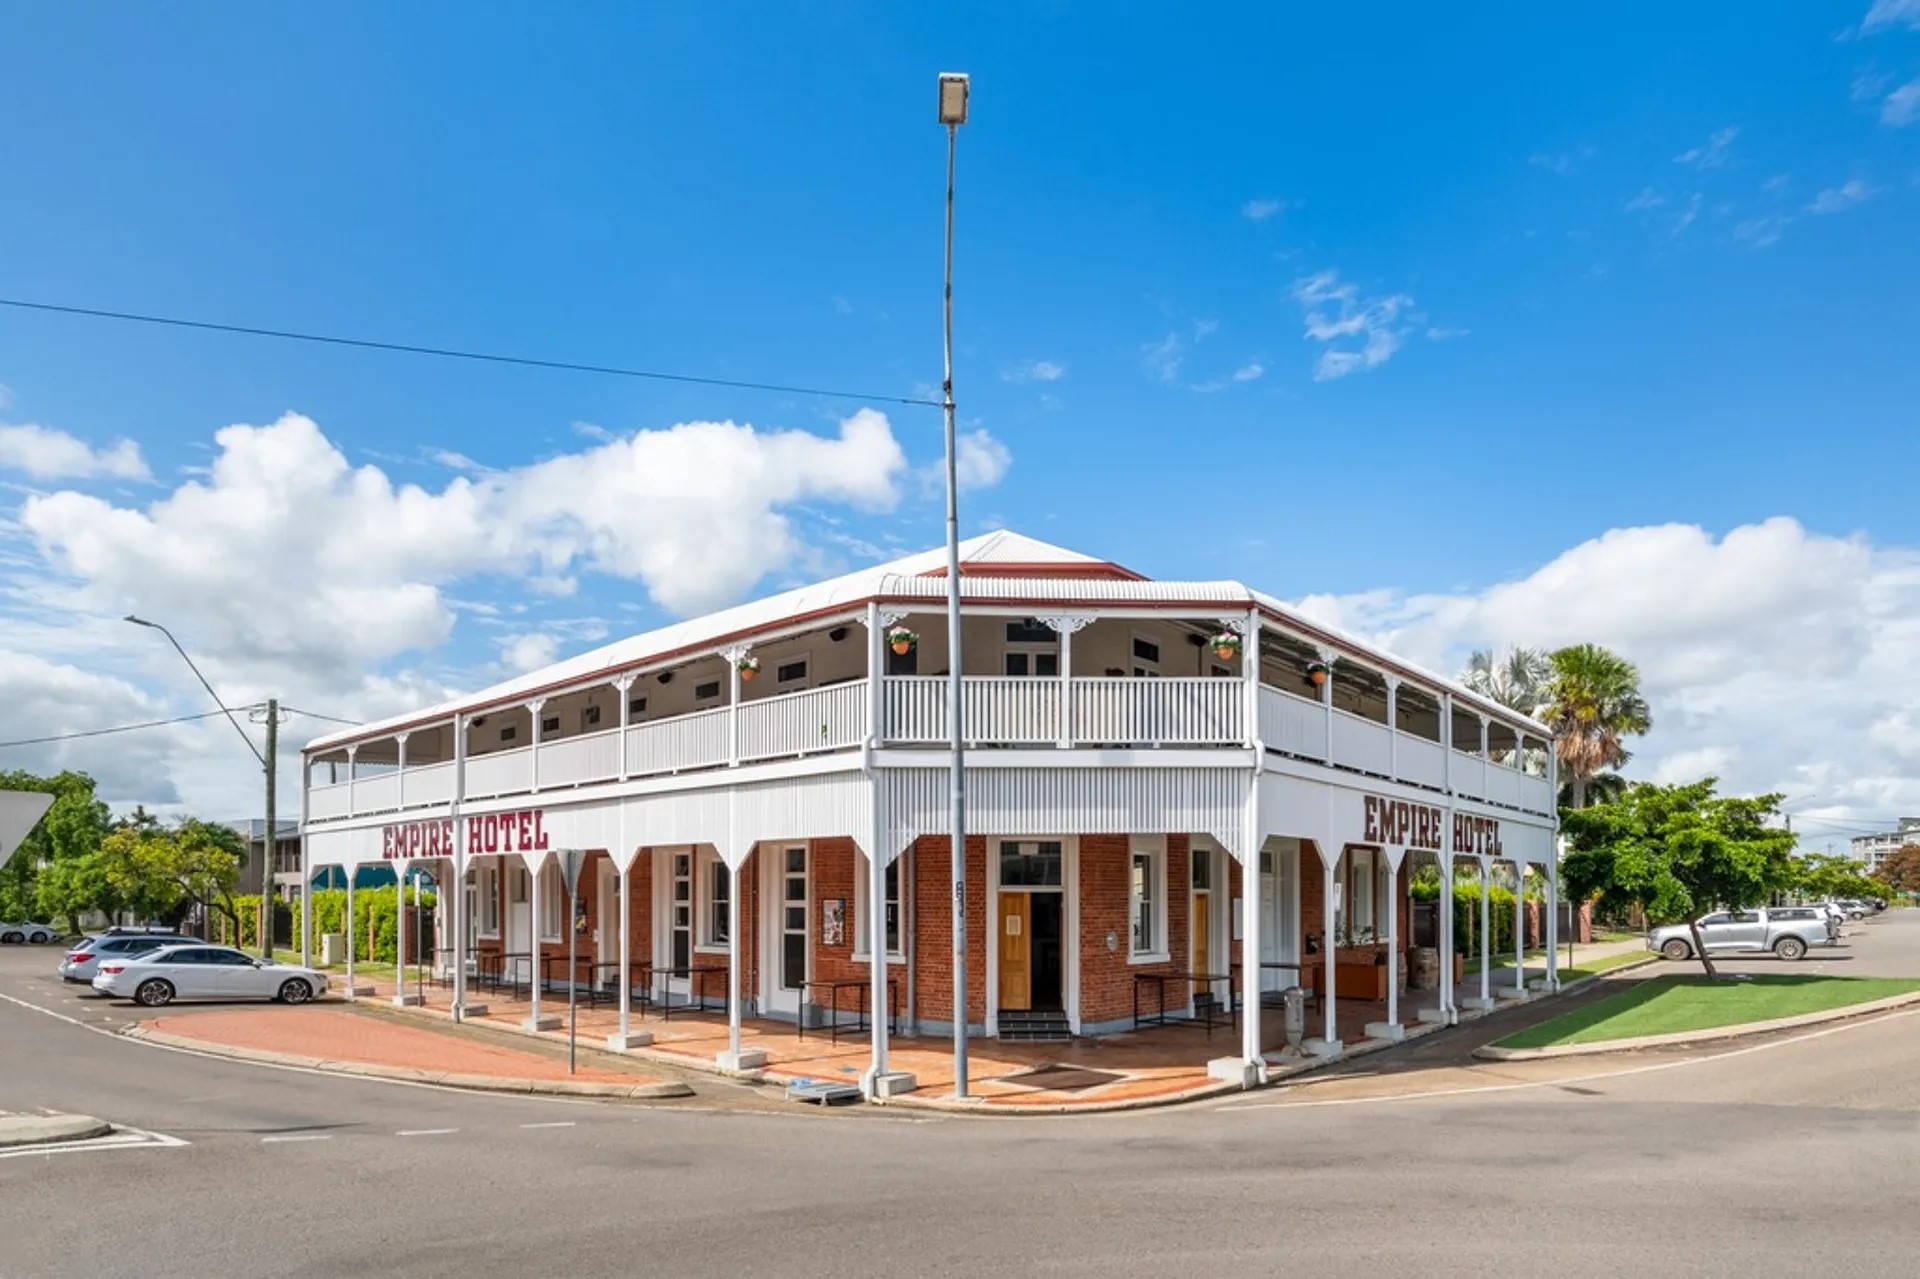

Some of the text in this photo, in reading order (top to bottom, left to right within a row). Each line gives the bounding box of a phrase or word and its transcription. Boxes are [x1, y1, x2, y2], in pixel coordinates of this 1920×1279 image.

[383, 810, 548, 859] EMPIRE HOTEL
[1364, 795, 1502, 856] EMPIRE HOTEL
